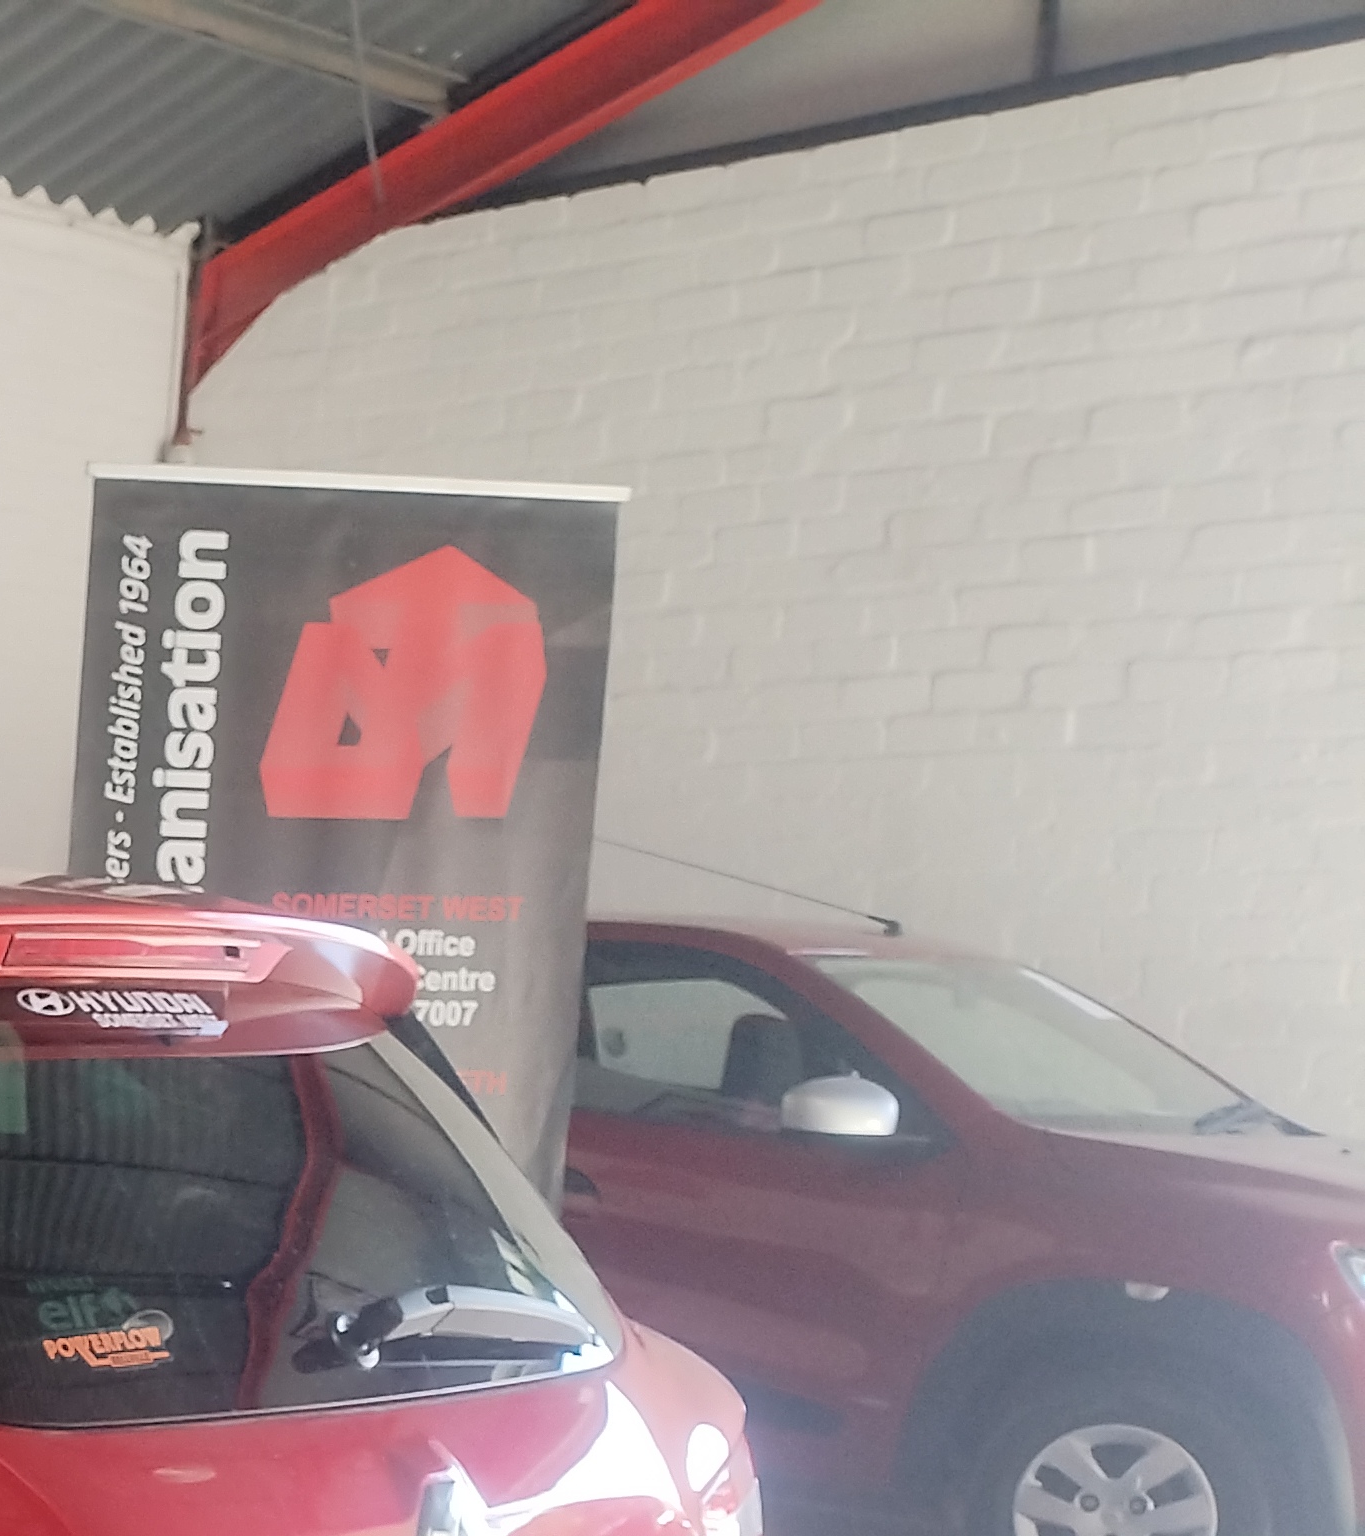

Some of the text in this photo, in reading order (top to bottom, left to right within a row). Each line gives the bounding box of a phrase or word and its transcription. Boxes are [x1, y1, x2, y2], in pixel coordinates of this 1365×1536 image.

[119, 534, 153, 614] 1964
[104, 620, 146, 804] Established
[152, 529, 229, 893] anisation
[105, 829, 132, 884] ers
[272, 891, 524, 922] SOMERSET WEST
[394, 929, 476, 957] Office
[70, 990, 213, 1014] HYUNDAI
